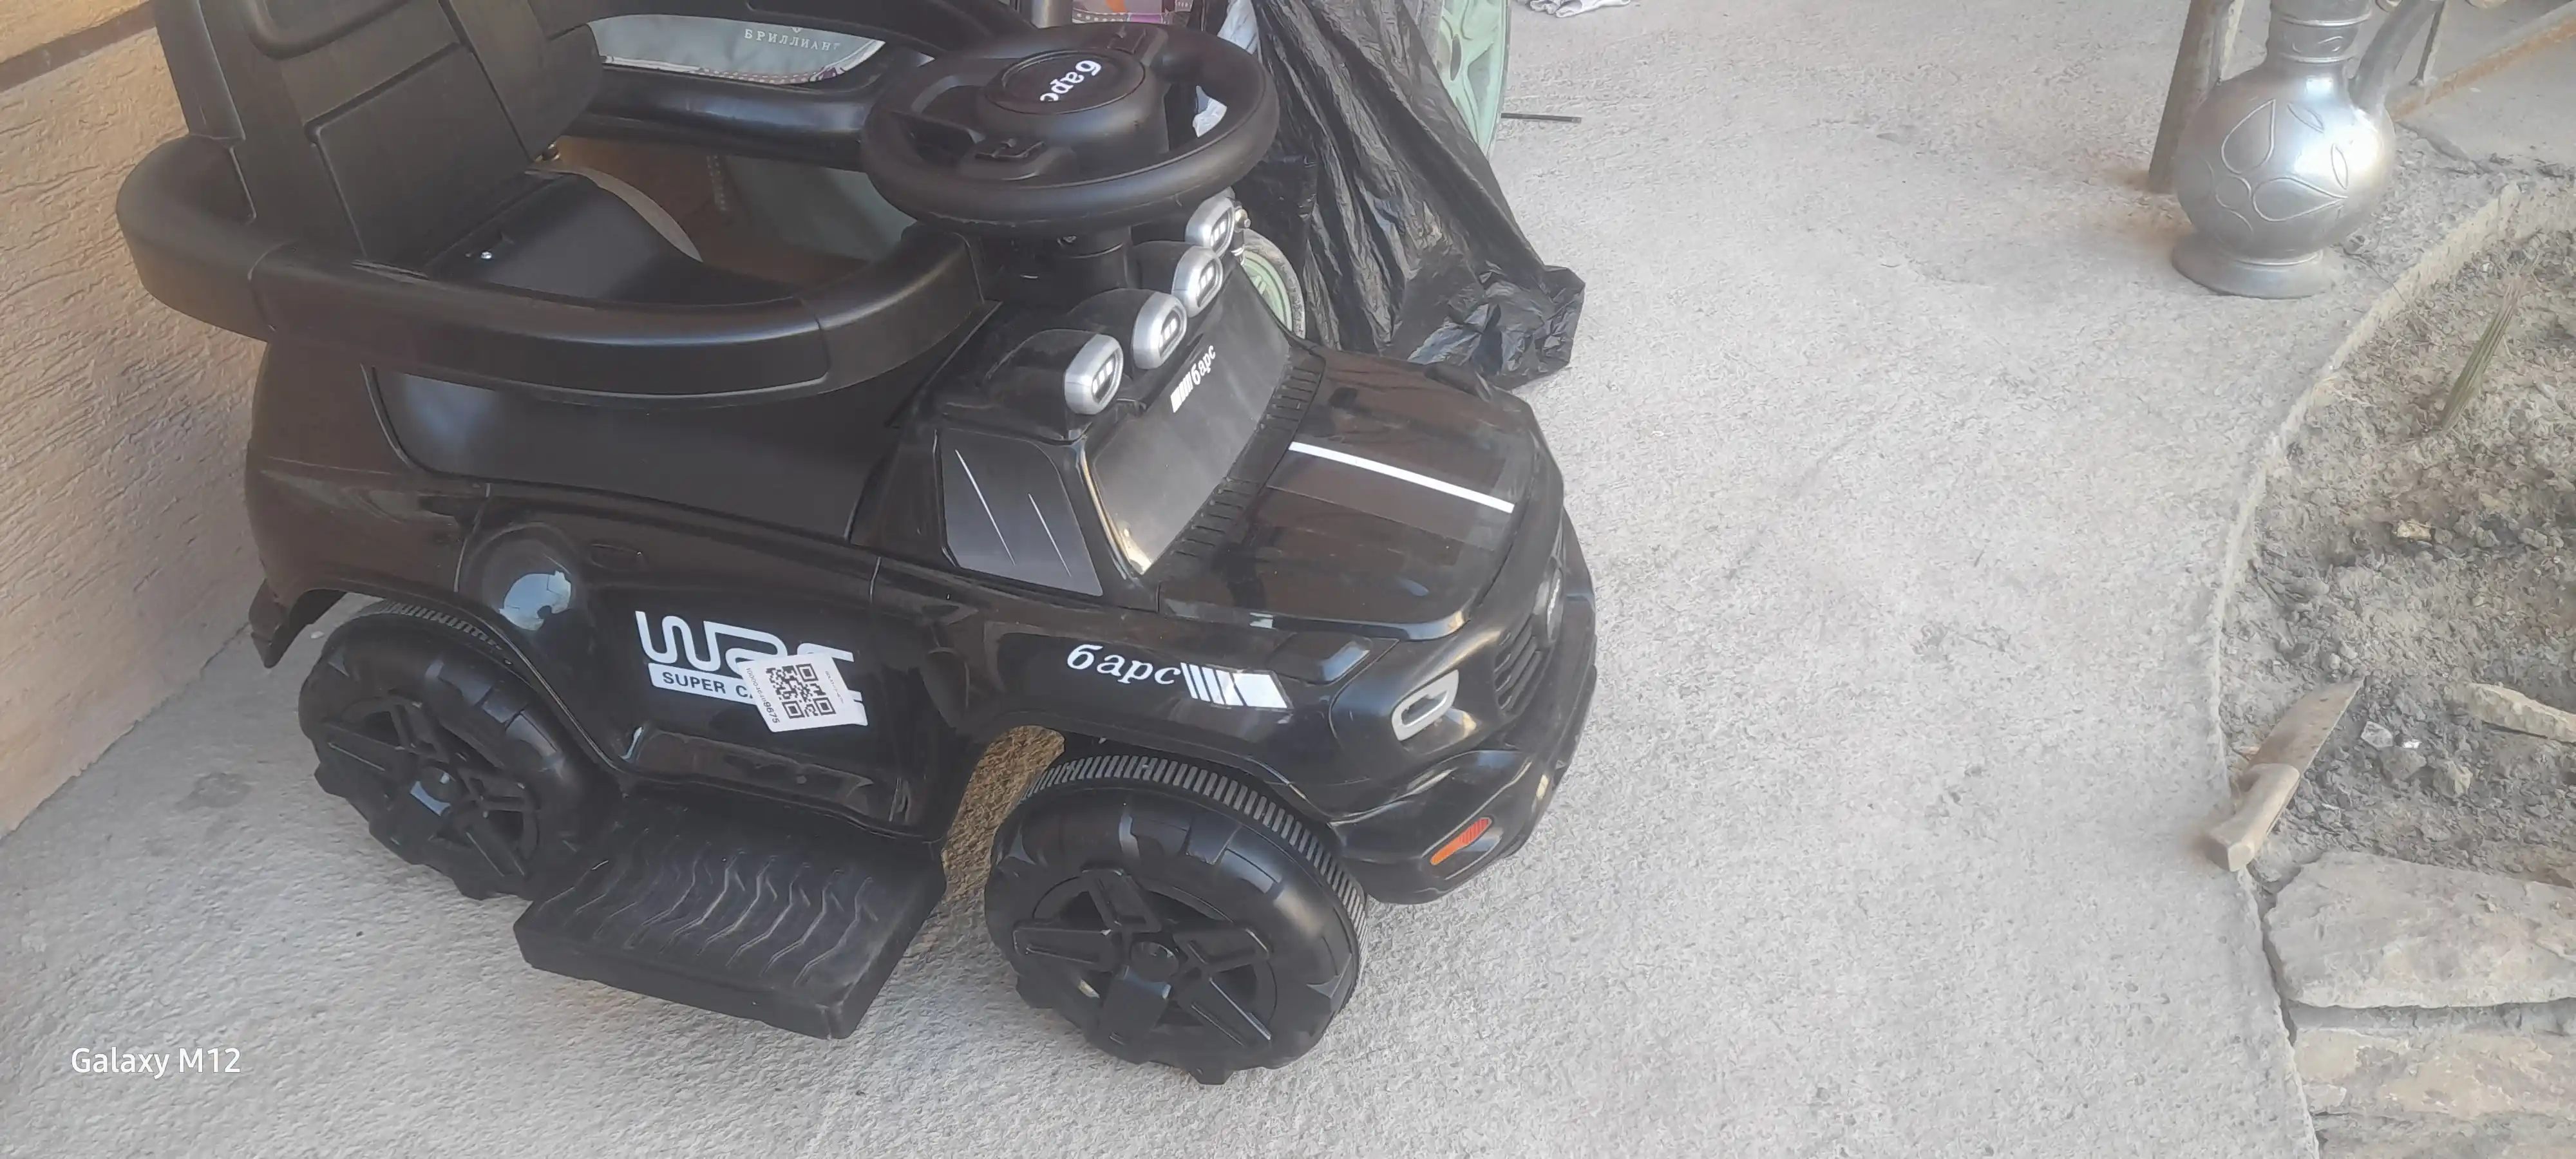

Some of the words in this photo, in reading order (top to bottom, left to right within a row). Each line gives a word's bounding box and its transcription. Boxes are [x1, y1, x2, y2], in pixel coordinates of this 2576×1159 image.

[1040, 60, 1101, 101] барс
[1191, 345, 1216, 385] барс
[662, 672, 726, 694] SUPER
[1067, 644, 1181, 684] барс
